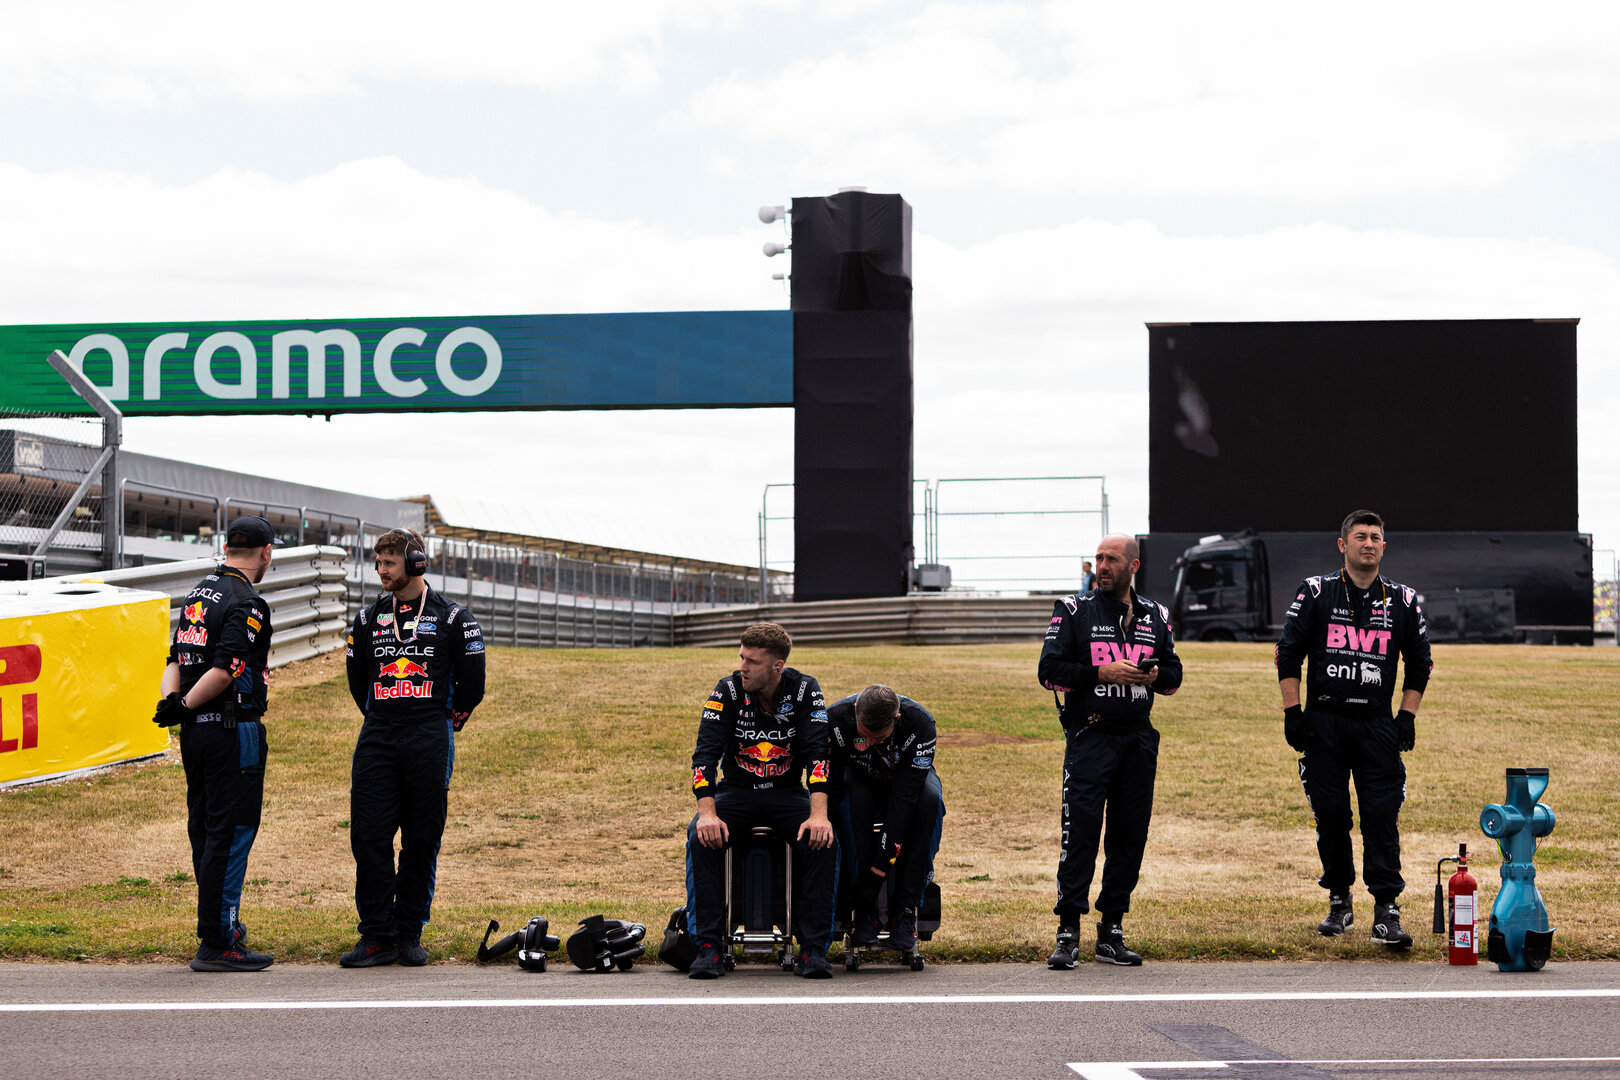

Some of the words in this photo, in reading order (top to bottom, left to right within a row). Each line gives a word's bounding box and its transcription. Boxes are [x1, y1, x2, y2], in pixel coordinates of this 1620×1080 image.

[67, 326, 504, 401] aramco
[373, 629, 389, 637] Mobil
[1326, 623, 1392, 655] BWT
[374, 646, 435, 657] ORACLE
[1090, 641, 1155, 667] BWT
[1356, 652, 1387, 660] TECHNOLOGY
[1326, 661, 1357, 680] eni
[703, 711, 720, 720] VISA
[735, 727, 797, 740] ORACLE
